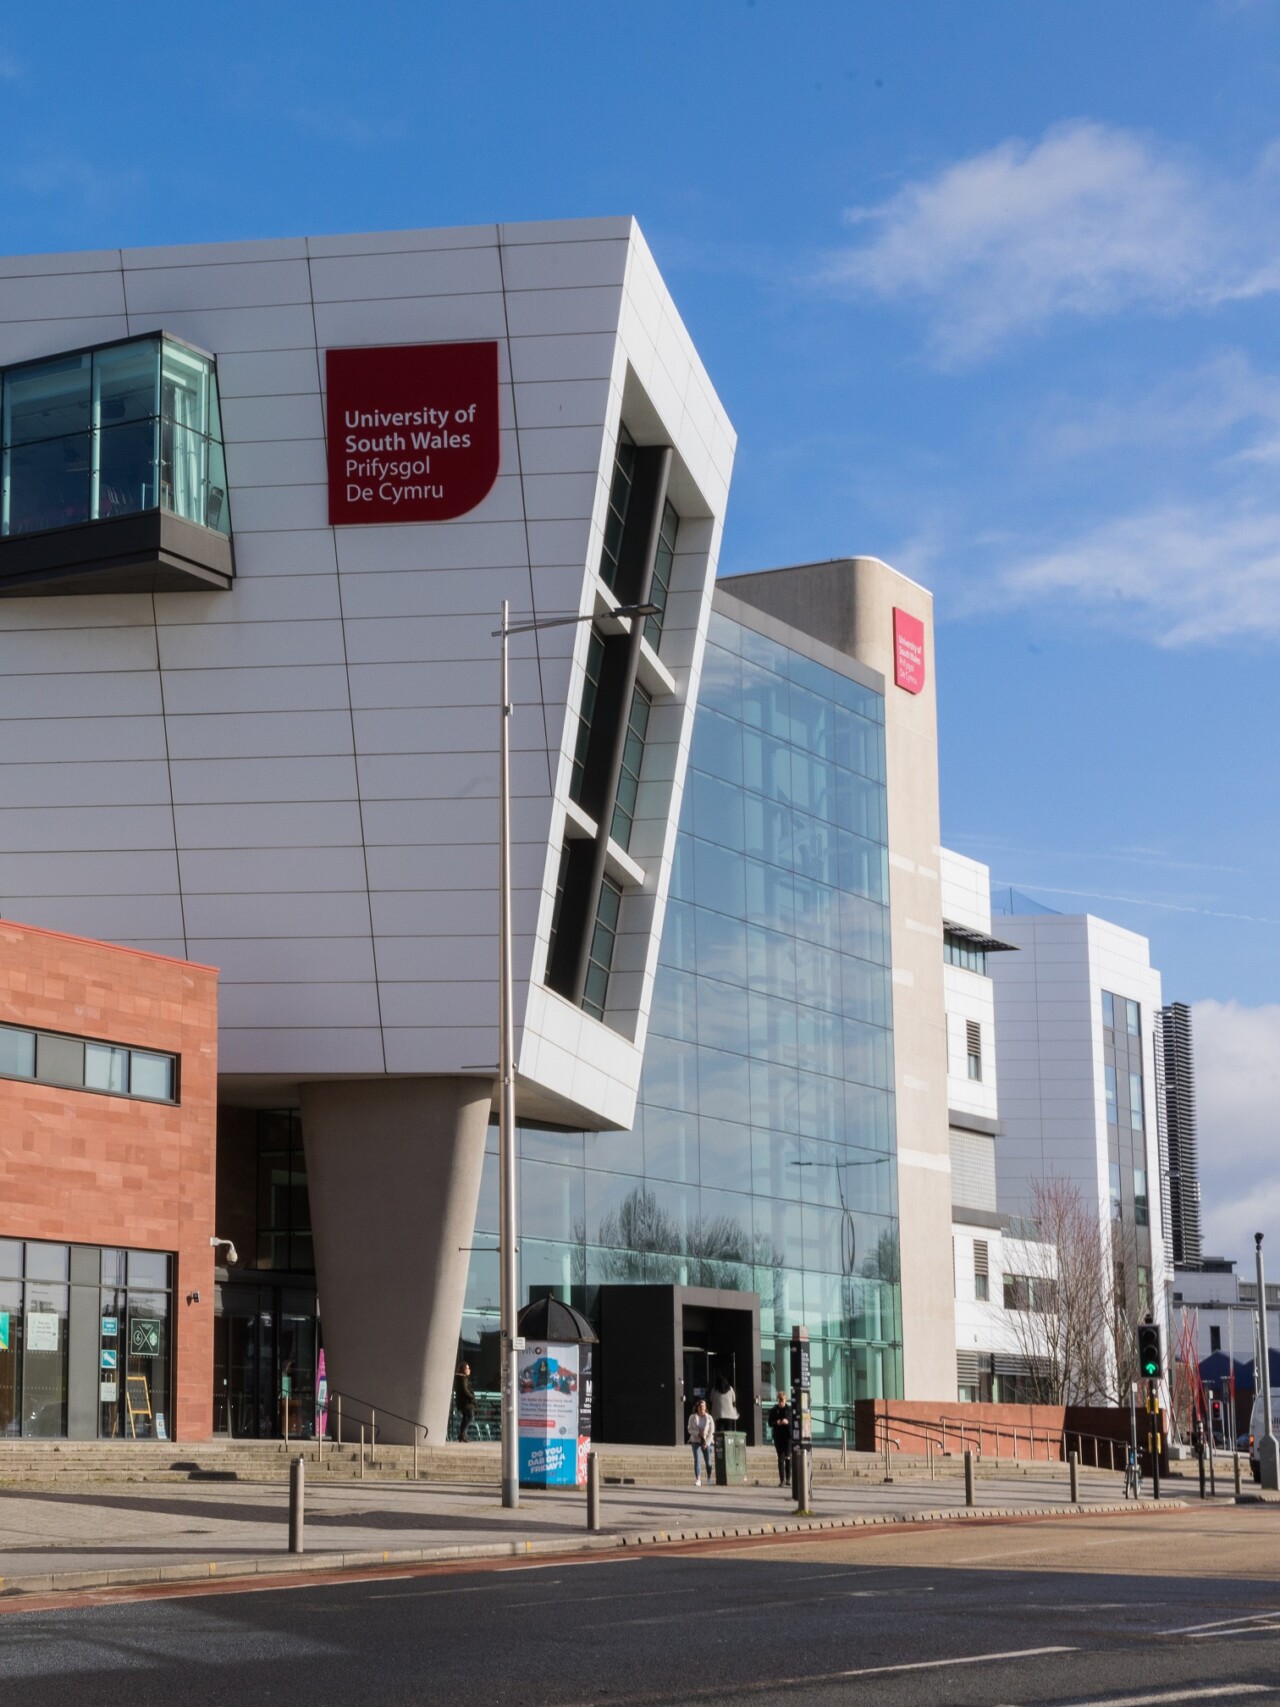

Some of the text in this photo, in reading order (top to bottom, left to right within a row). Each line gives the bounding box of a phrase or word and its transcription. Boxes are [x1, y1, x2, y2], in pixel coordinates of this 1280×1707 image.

[344, 403, 477, 429] University of
[345, 431, 472, 453] South Wales
[346, 456, 431, 481] Prifysgol
[346, 482, 444, 505] De Cymru
[528, 1457, 545, 1467] DAB
[531, 1446, 563, 1459] DO YOU
[530, 1461, 563, 1474] FRIDAY?
